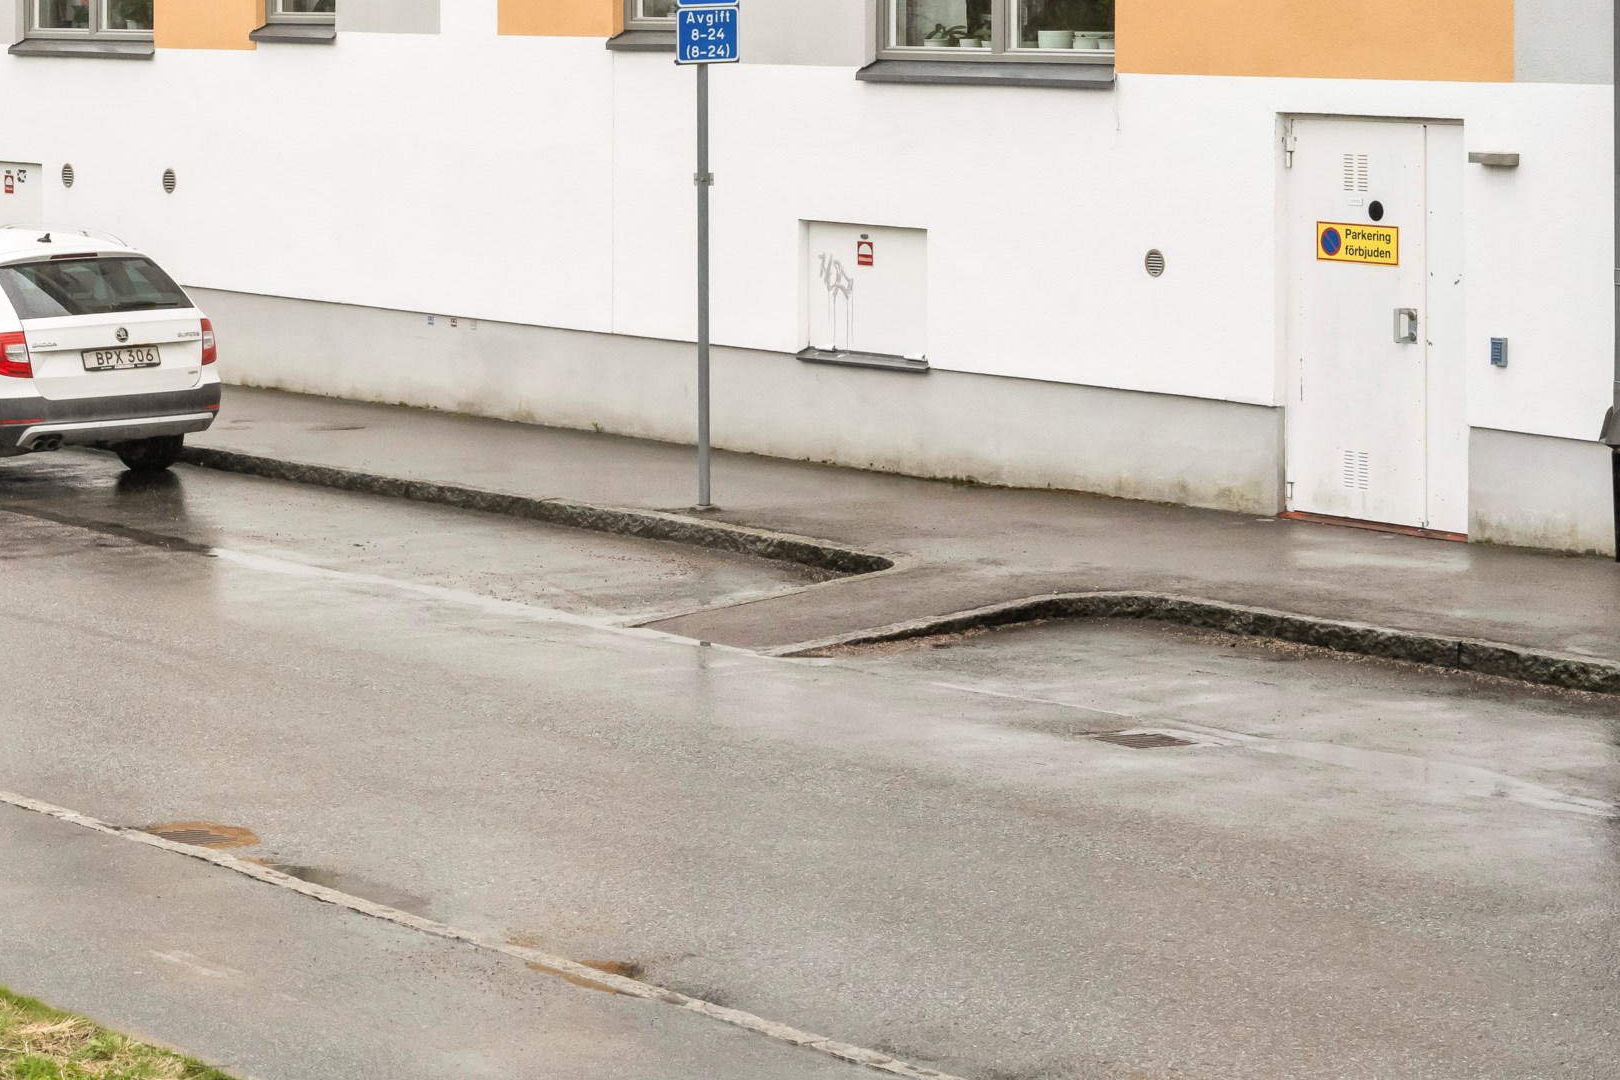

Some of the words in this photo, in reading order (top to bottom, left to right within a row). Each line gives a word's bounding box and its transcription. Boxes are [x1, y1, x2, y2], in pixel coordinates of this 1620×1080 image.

[686, 10, 731, 26] Avgift
[691, 28, 726, 41] 8-24
[686, 43, 730, 59] (8-24)
[1345, 228, 1391, 245] Parkering
[1345, 245, 1390, 259] förbjuden
[95, 350, 124, 366] BPX
[127, 348, 154, 363] 306
